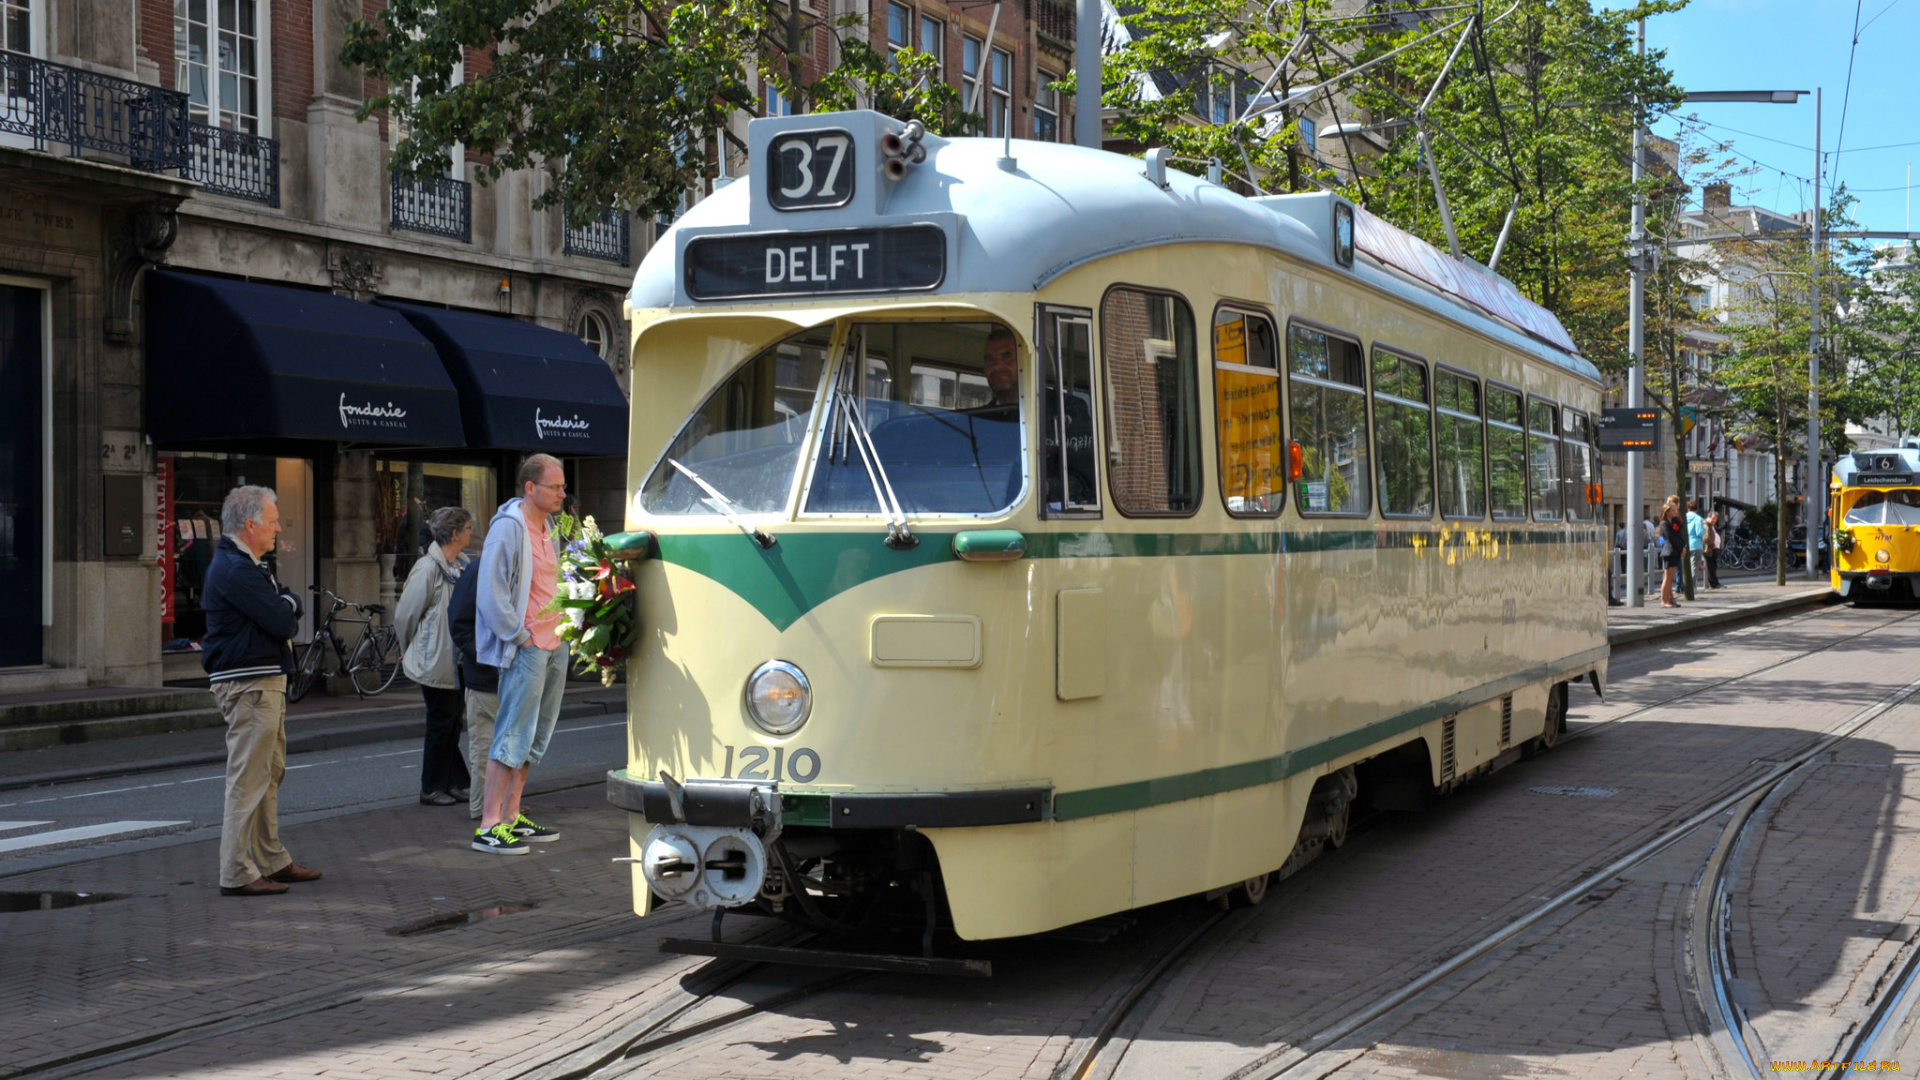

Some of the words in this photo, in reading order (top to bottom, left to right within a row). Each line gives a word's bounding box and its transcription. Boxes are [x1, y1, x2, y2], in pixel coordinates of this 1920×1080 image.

[779, 135, 849, 199] 37
[33, 211, 74, 230] TWEE
[765, 243, 870, 284] DELFT
[339, 392, 407, 429] fonderie
[348, 418, 370, 426] SUITS
[380, 420, 408, 428] CASUAL
[535, 407, 589, 440] fonderie
[568, 431, 590, 439] CASUAL
[1881, 457, 1890, 469] 6
[1863, 476, 1907, 484] Leidschendam
[1874, 533, 1893, 541] HTM
[720, 745, 822, 784] 1210
